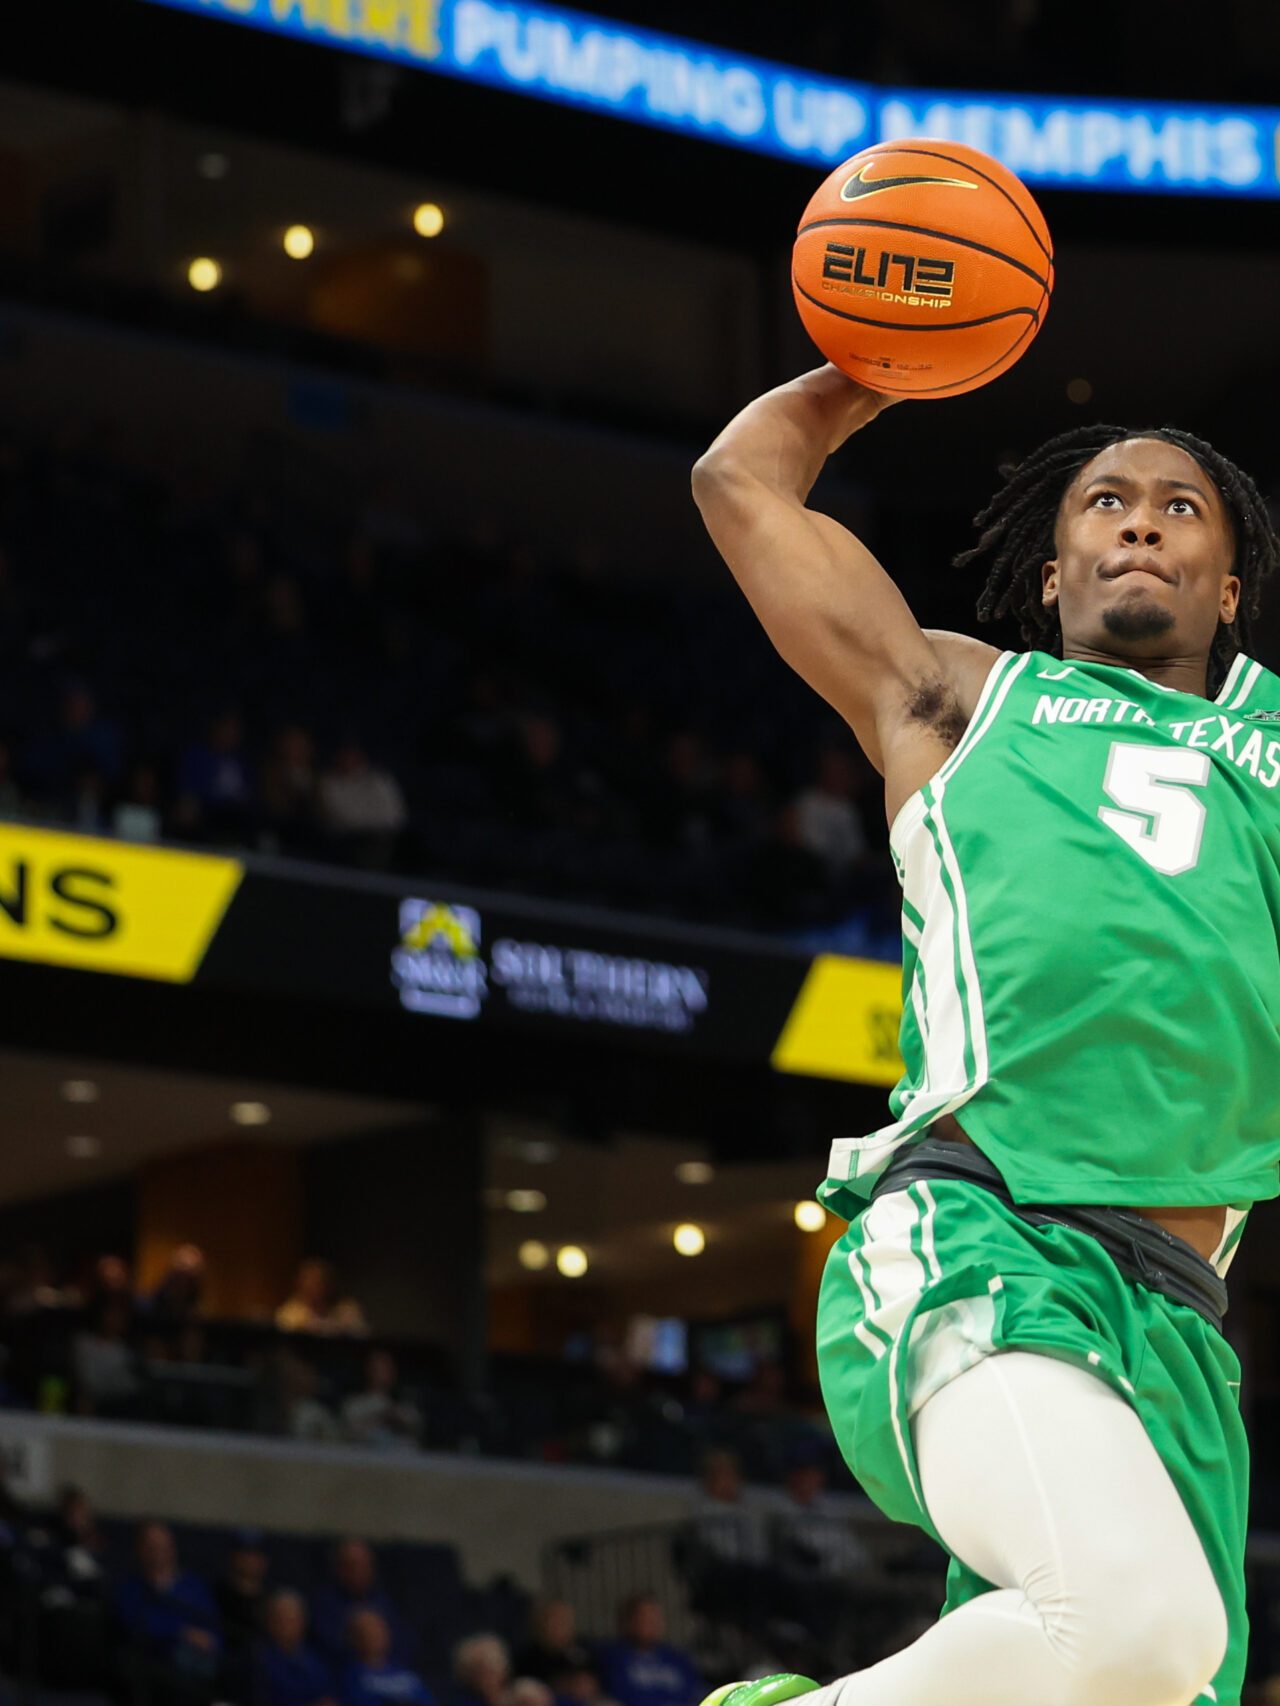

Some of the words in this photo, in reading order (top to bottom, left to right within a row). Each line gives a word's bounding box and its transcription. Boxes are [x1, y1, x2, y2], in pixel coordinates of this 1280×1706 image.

[453, 0, 766, 137] PUMPING
[773, 80, 867, 157] UP
[822, 242, 955, 299] ELITE
[1097, 741, 1212, 877] 5
